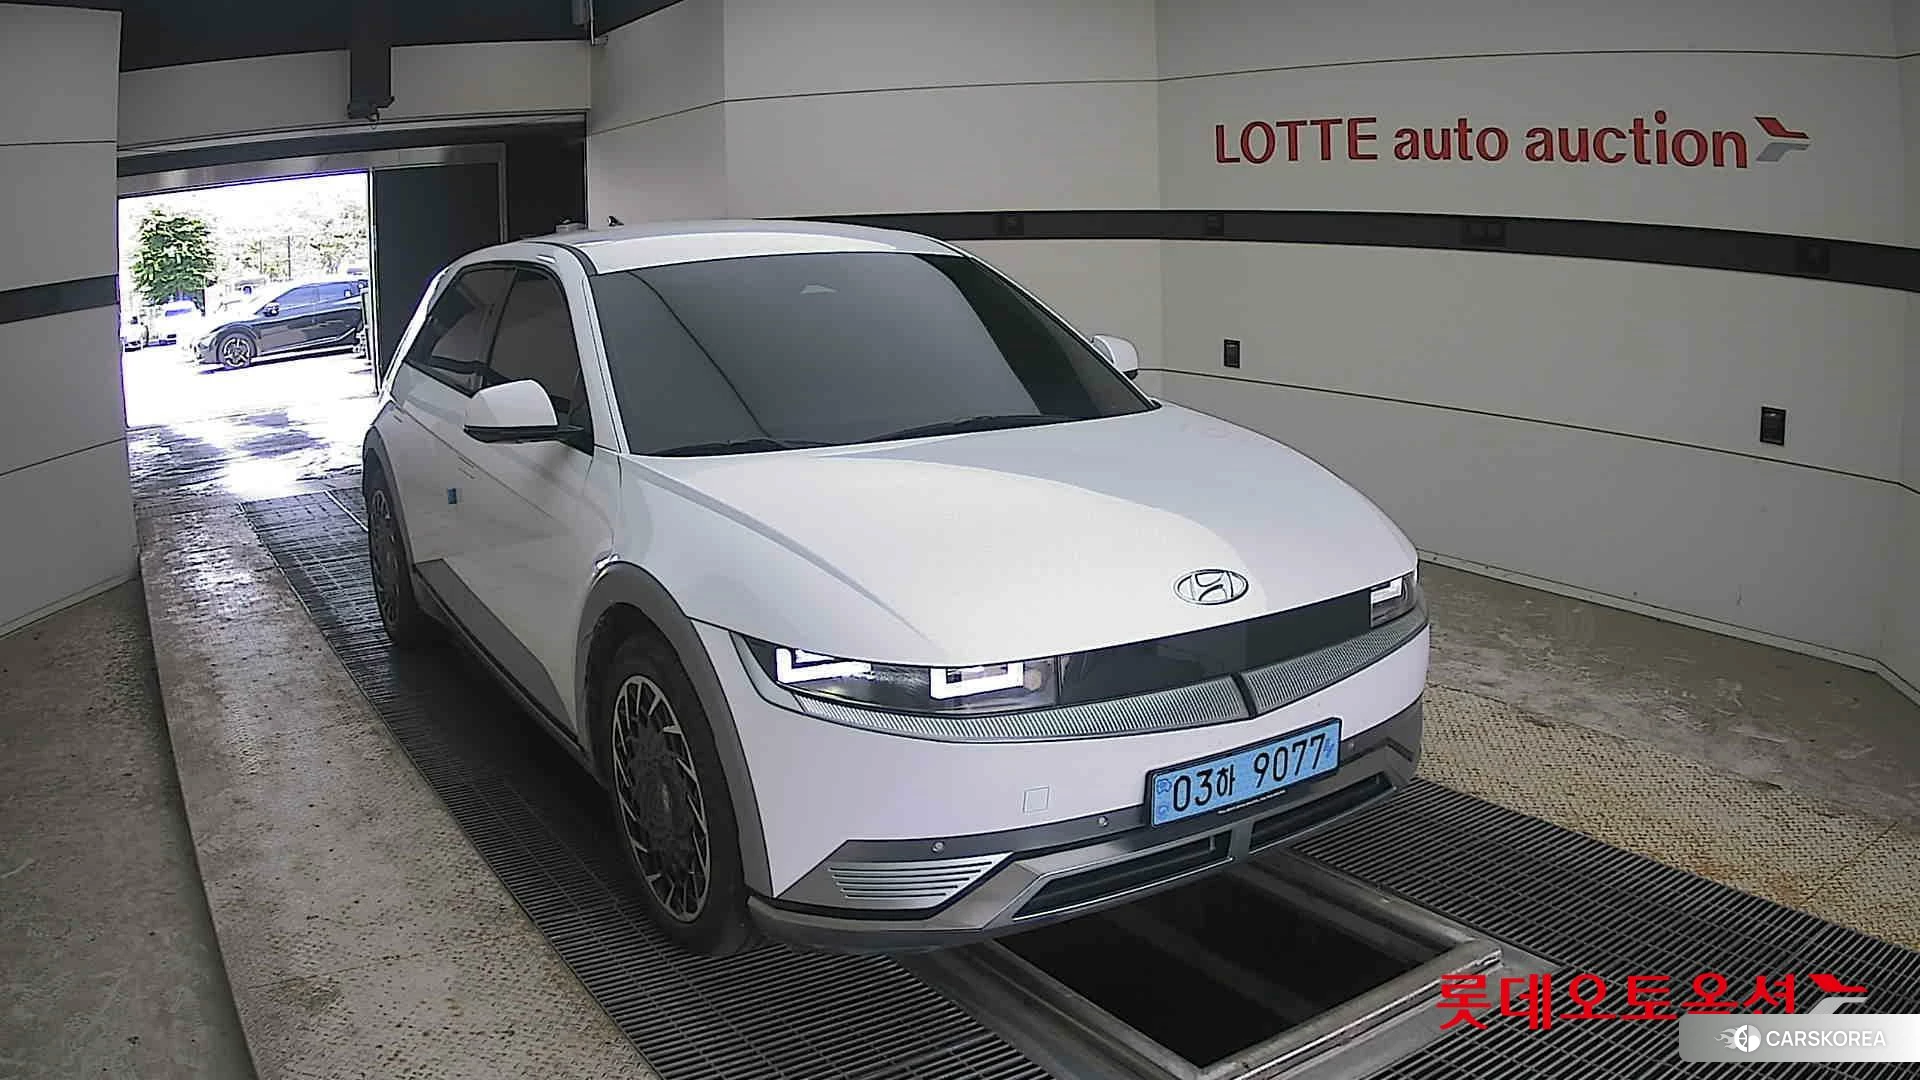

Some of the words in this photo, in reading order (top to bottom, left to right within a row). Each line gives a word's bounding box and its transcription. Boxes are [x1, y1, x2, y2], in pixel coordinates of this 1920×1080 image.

[1216, 117, 1377, 164] LOTTE
[1394, 118, 1508, 161] auto
[1525, 110, 1748, 168] auction
[1173, 764, 1236, 812] 03하
[1253, 733, 1327, 788] 9077
